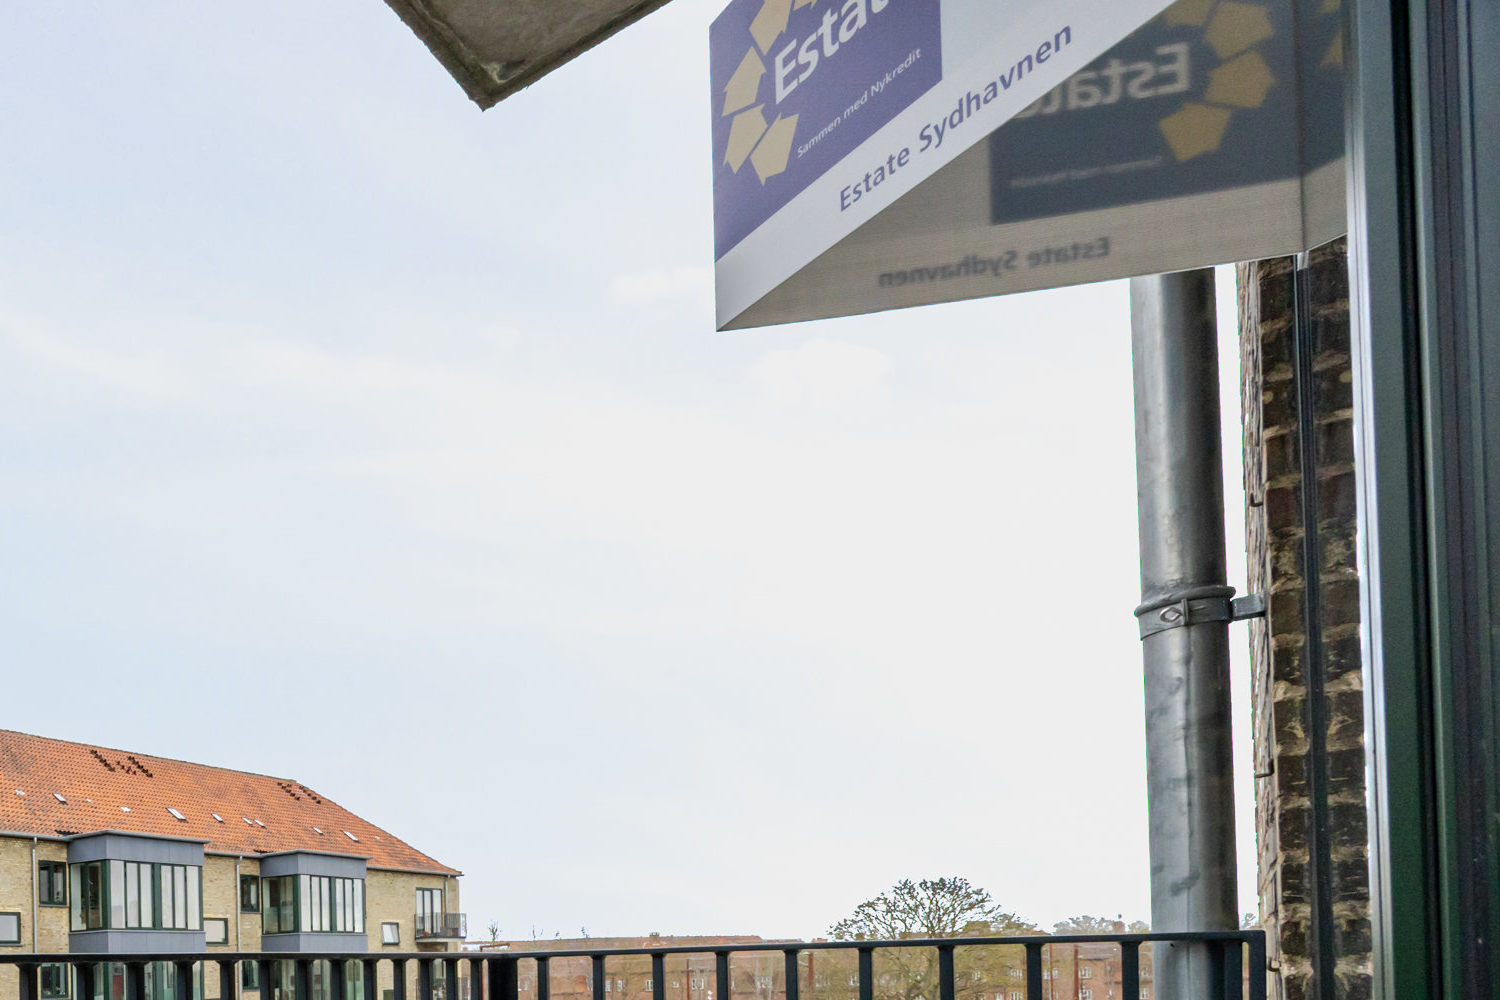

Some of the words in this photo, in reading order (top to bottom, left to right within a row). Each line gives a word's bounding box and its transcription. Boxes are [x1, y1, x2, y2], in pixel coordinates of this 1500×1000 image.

[797, 116, 841, 158] Sammen
[843, 91, 868, 119] med
[870, 48, 922, 97] Nykredit
[840, 147, 910, 212] Estate
[919, 25, 1071, 153] Sydhavnen
